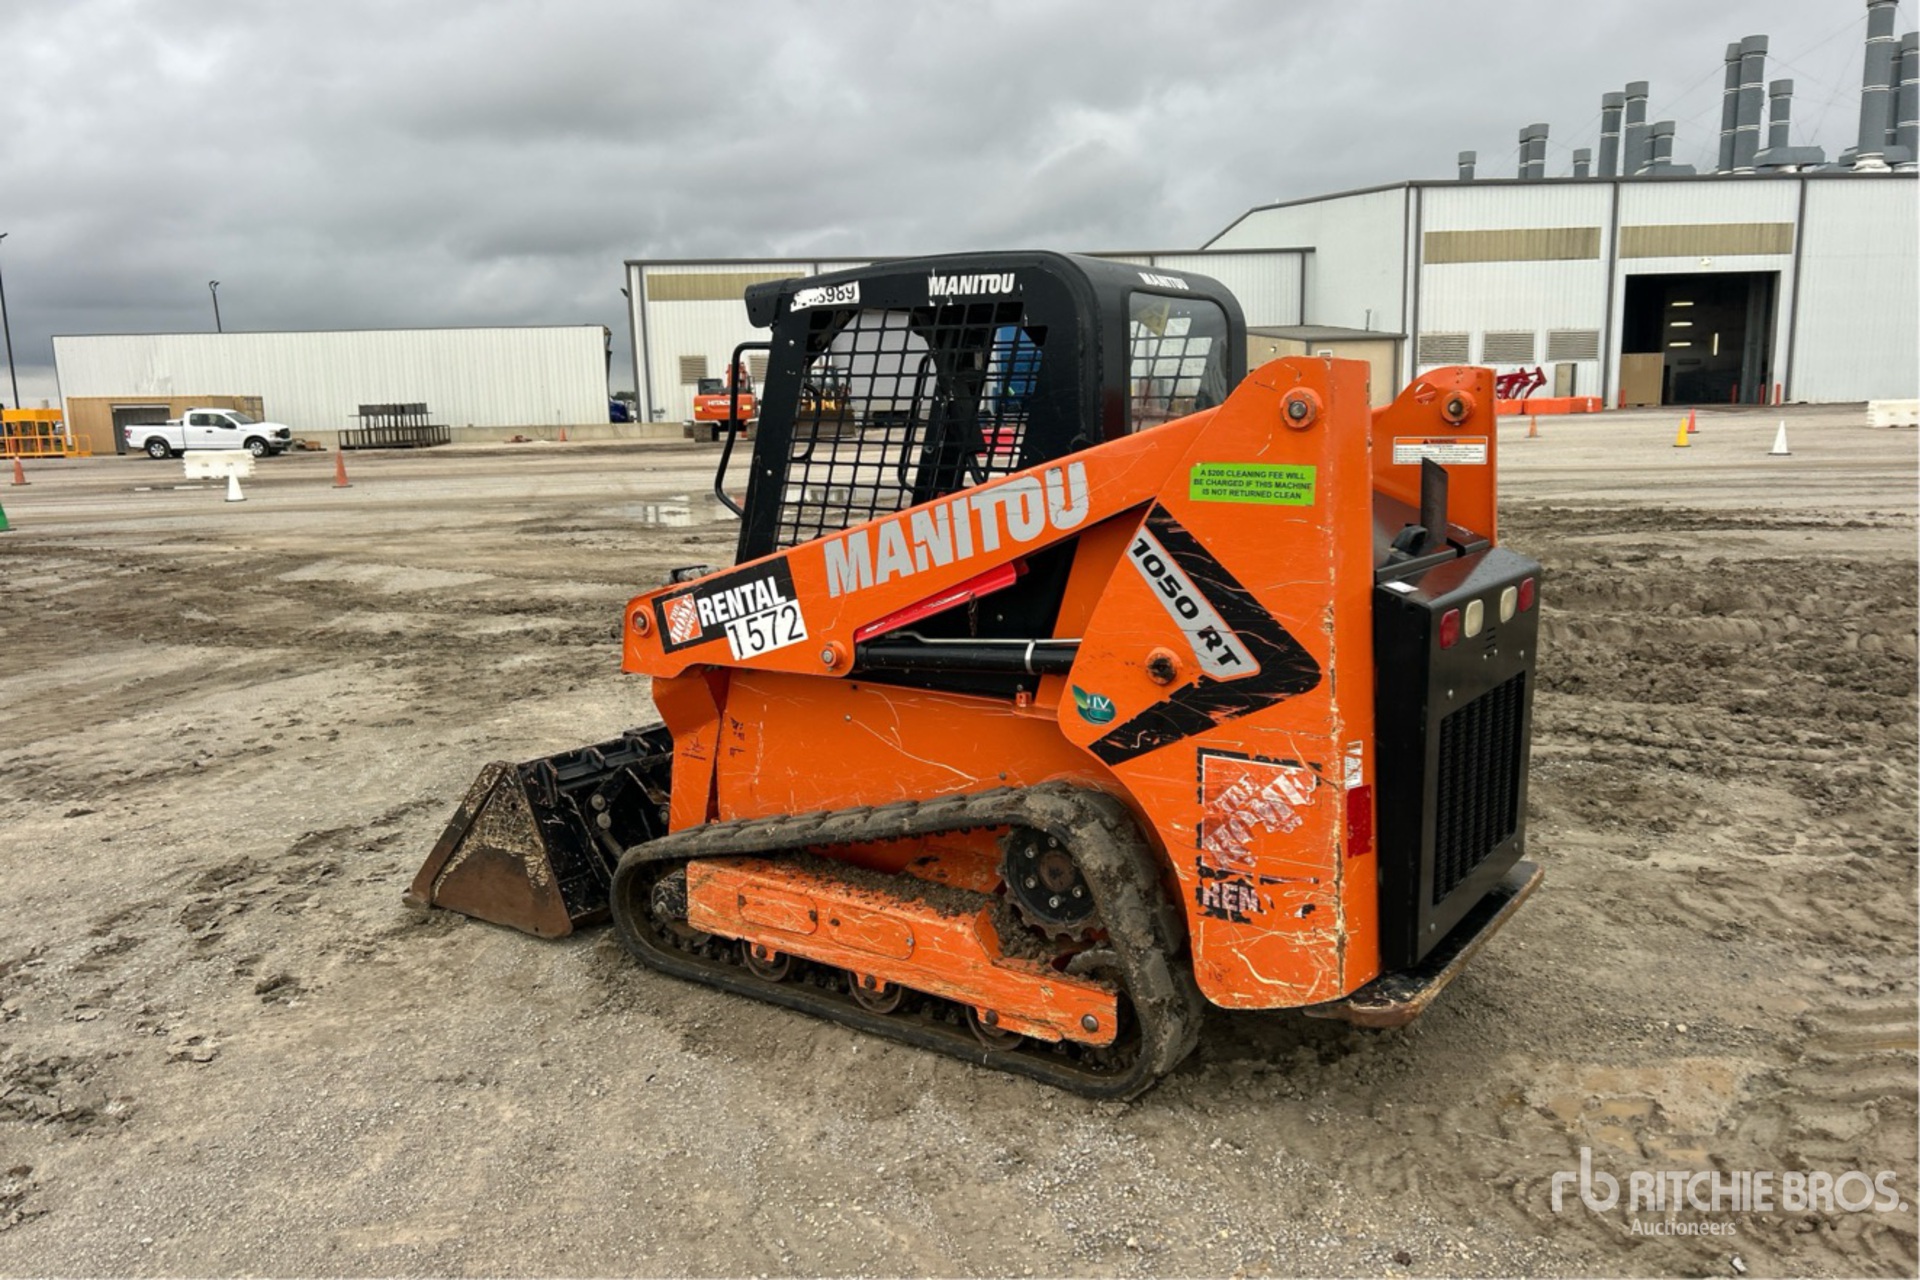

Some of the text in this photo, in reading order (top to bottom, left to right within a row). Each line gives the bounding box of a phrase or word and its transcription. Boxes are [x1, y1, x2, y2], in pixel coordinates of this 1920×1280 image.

[928, 273, 1015, 296] MANITOU
[1138, 272, 1189, 290] MANITOU
[1193, 478, 1203, 486] BE
[1205, 479, 1244, 487] CHARGED
[1255, 480, 1272, 488] THIS
[1226, 470, 1267, 478] CLEANING
[1268, 471, 1284, 479] FEE
[1285, 472, 1306, 480] WILL
[1229, 489, 1272, 498] RETURNED
[1273, 491, 1302, 500] CLEAN
[823, 461, 1090, 598] MANITOU
[697, 576, 788, 628] RENTAL
[1132, 538, 1242, 666] 1050 RT
[728, 604, 804, 657] 1572
